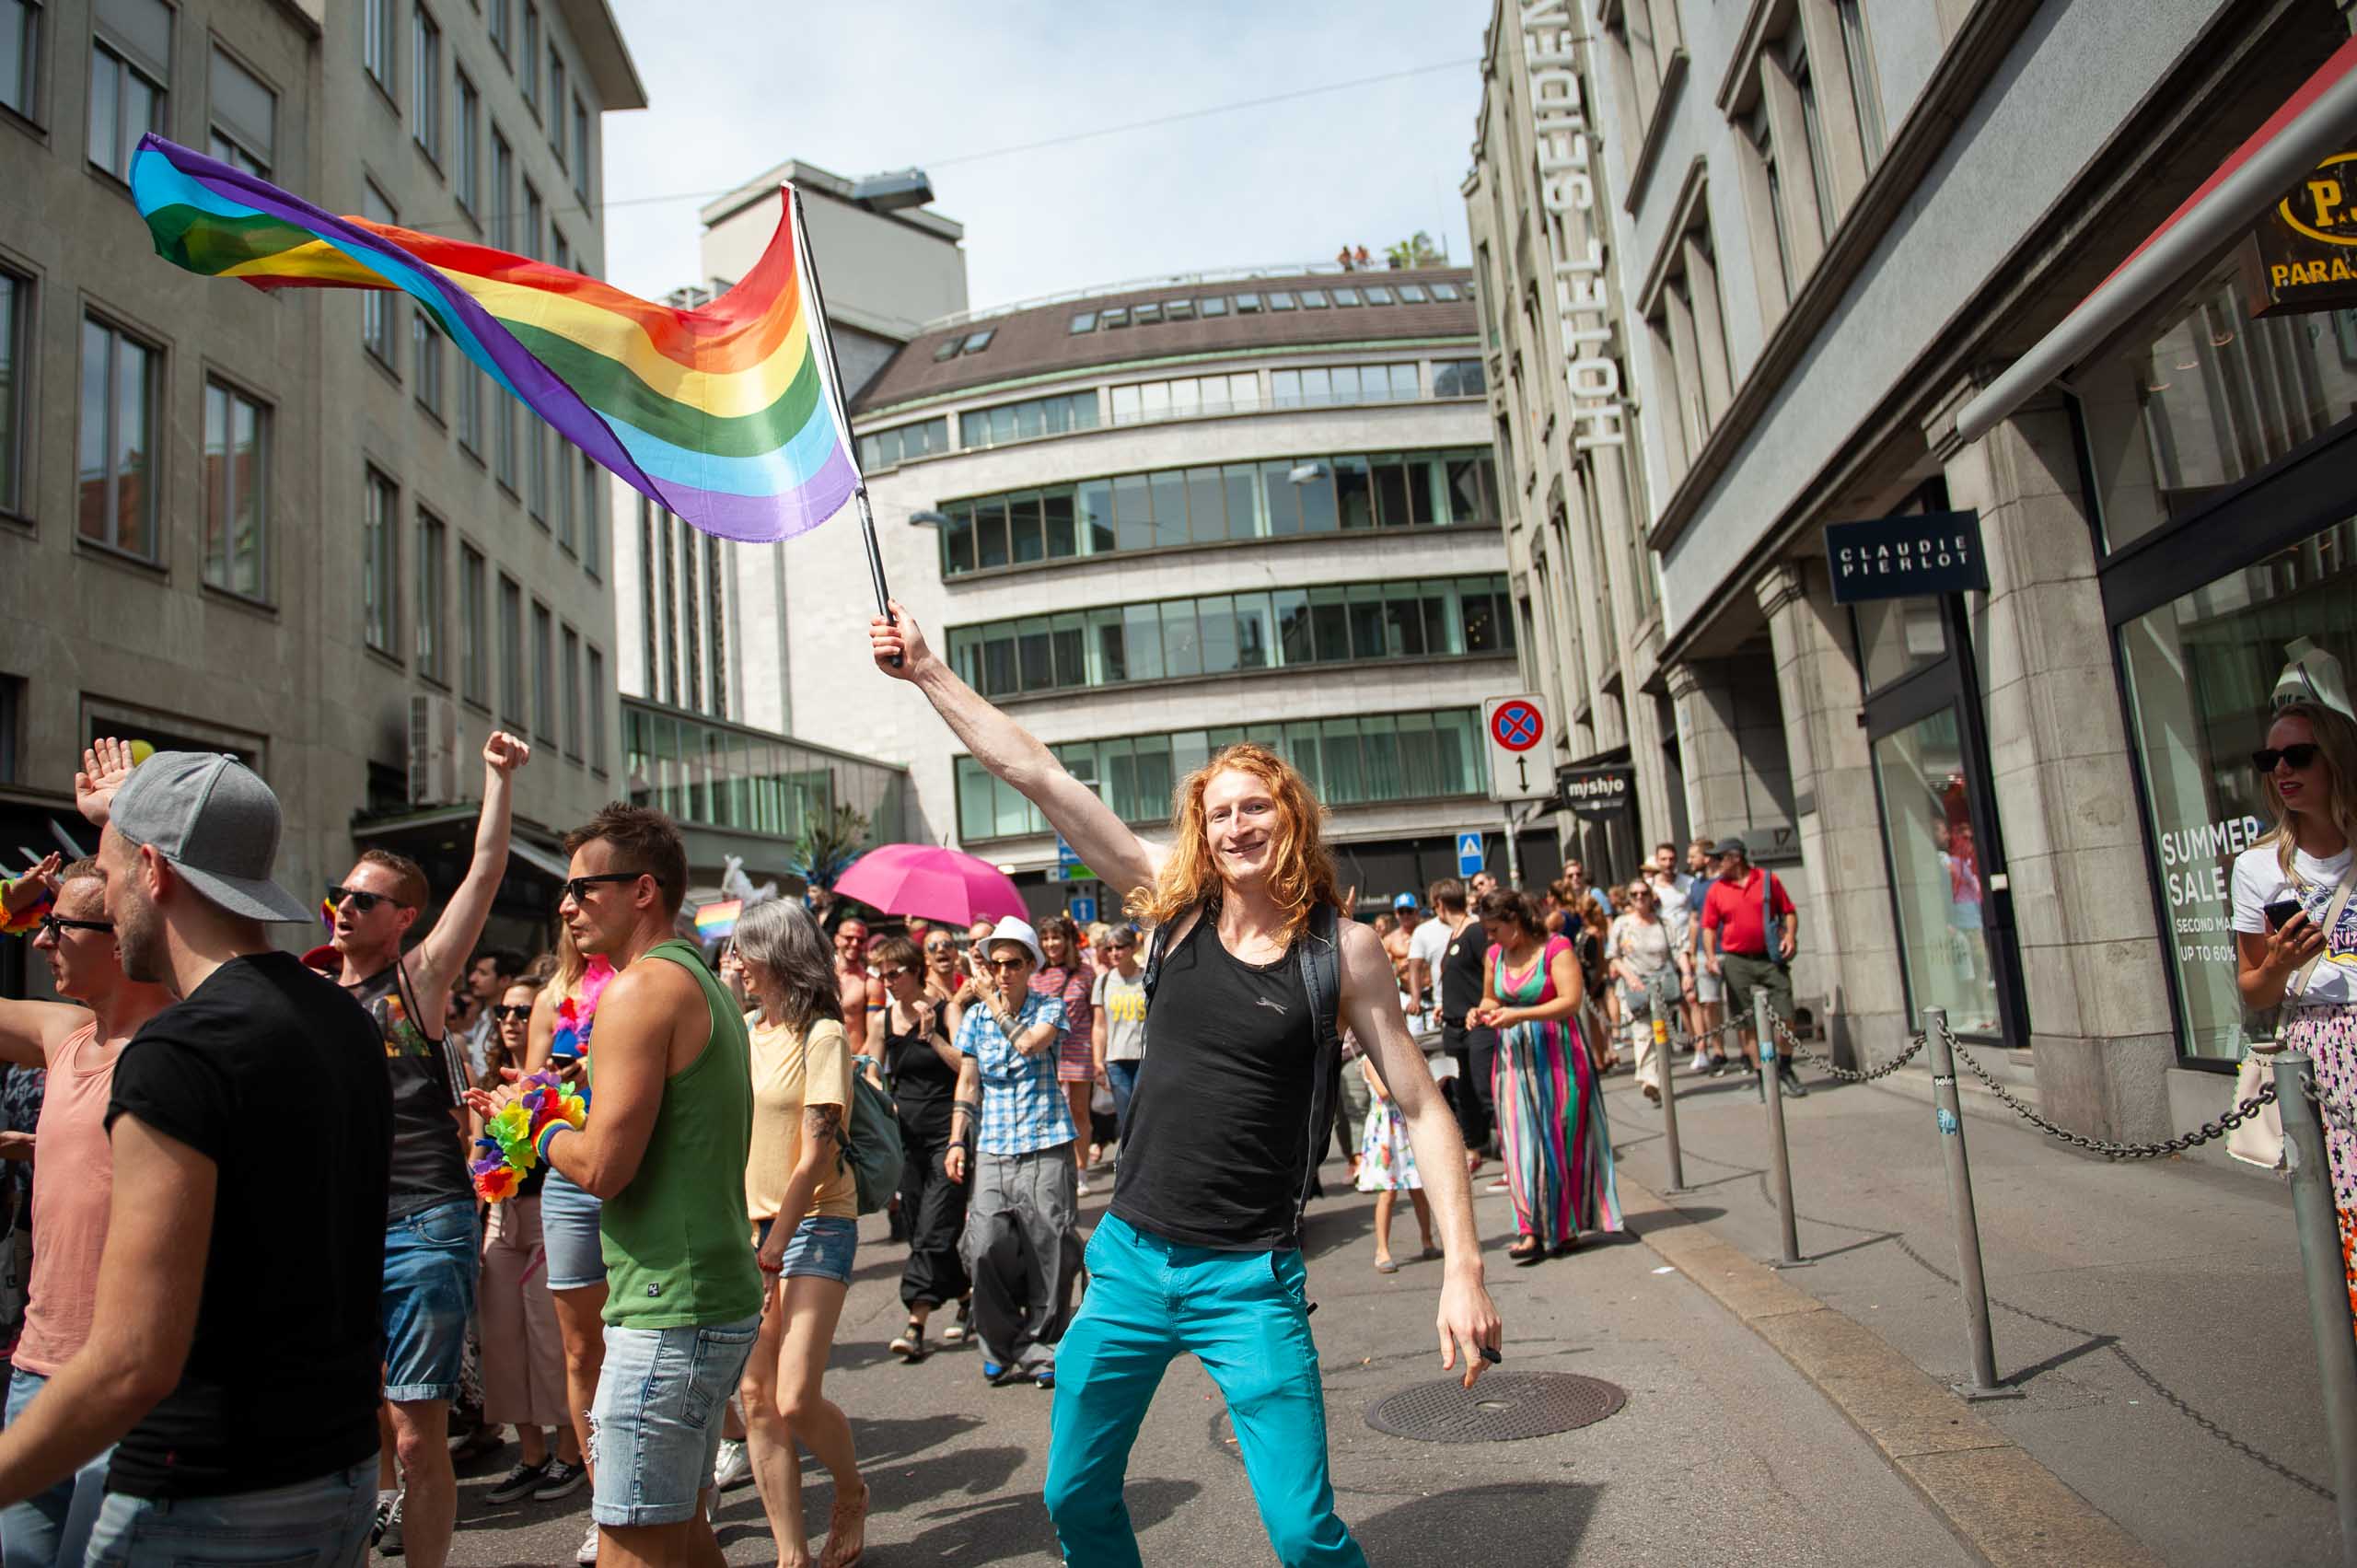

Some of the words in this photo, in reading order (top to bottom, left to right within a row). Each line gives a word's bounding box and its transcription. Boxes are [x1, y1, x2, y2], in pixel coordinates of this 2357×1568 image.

[1553, 238, 1626, 449] HOTEL
[1840, 536, 1968, 562] CLAUDIE
[1842, 551, 1968, 577] PIERLOT
[1773, 828, 1792, 845] 17
[2161, 816, 2259, 865] SUMMER
[2169, 866, 2228, 907] SALE
[2176, 917, 2213, 933] SECOND
[2215, 916, 2235, 932] MA
[2179, 946, 2194, 961] UP
[2196, 946, 2211, 961] TO
[2213, 945, 2237, 961] 60%
